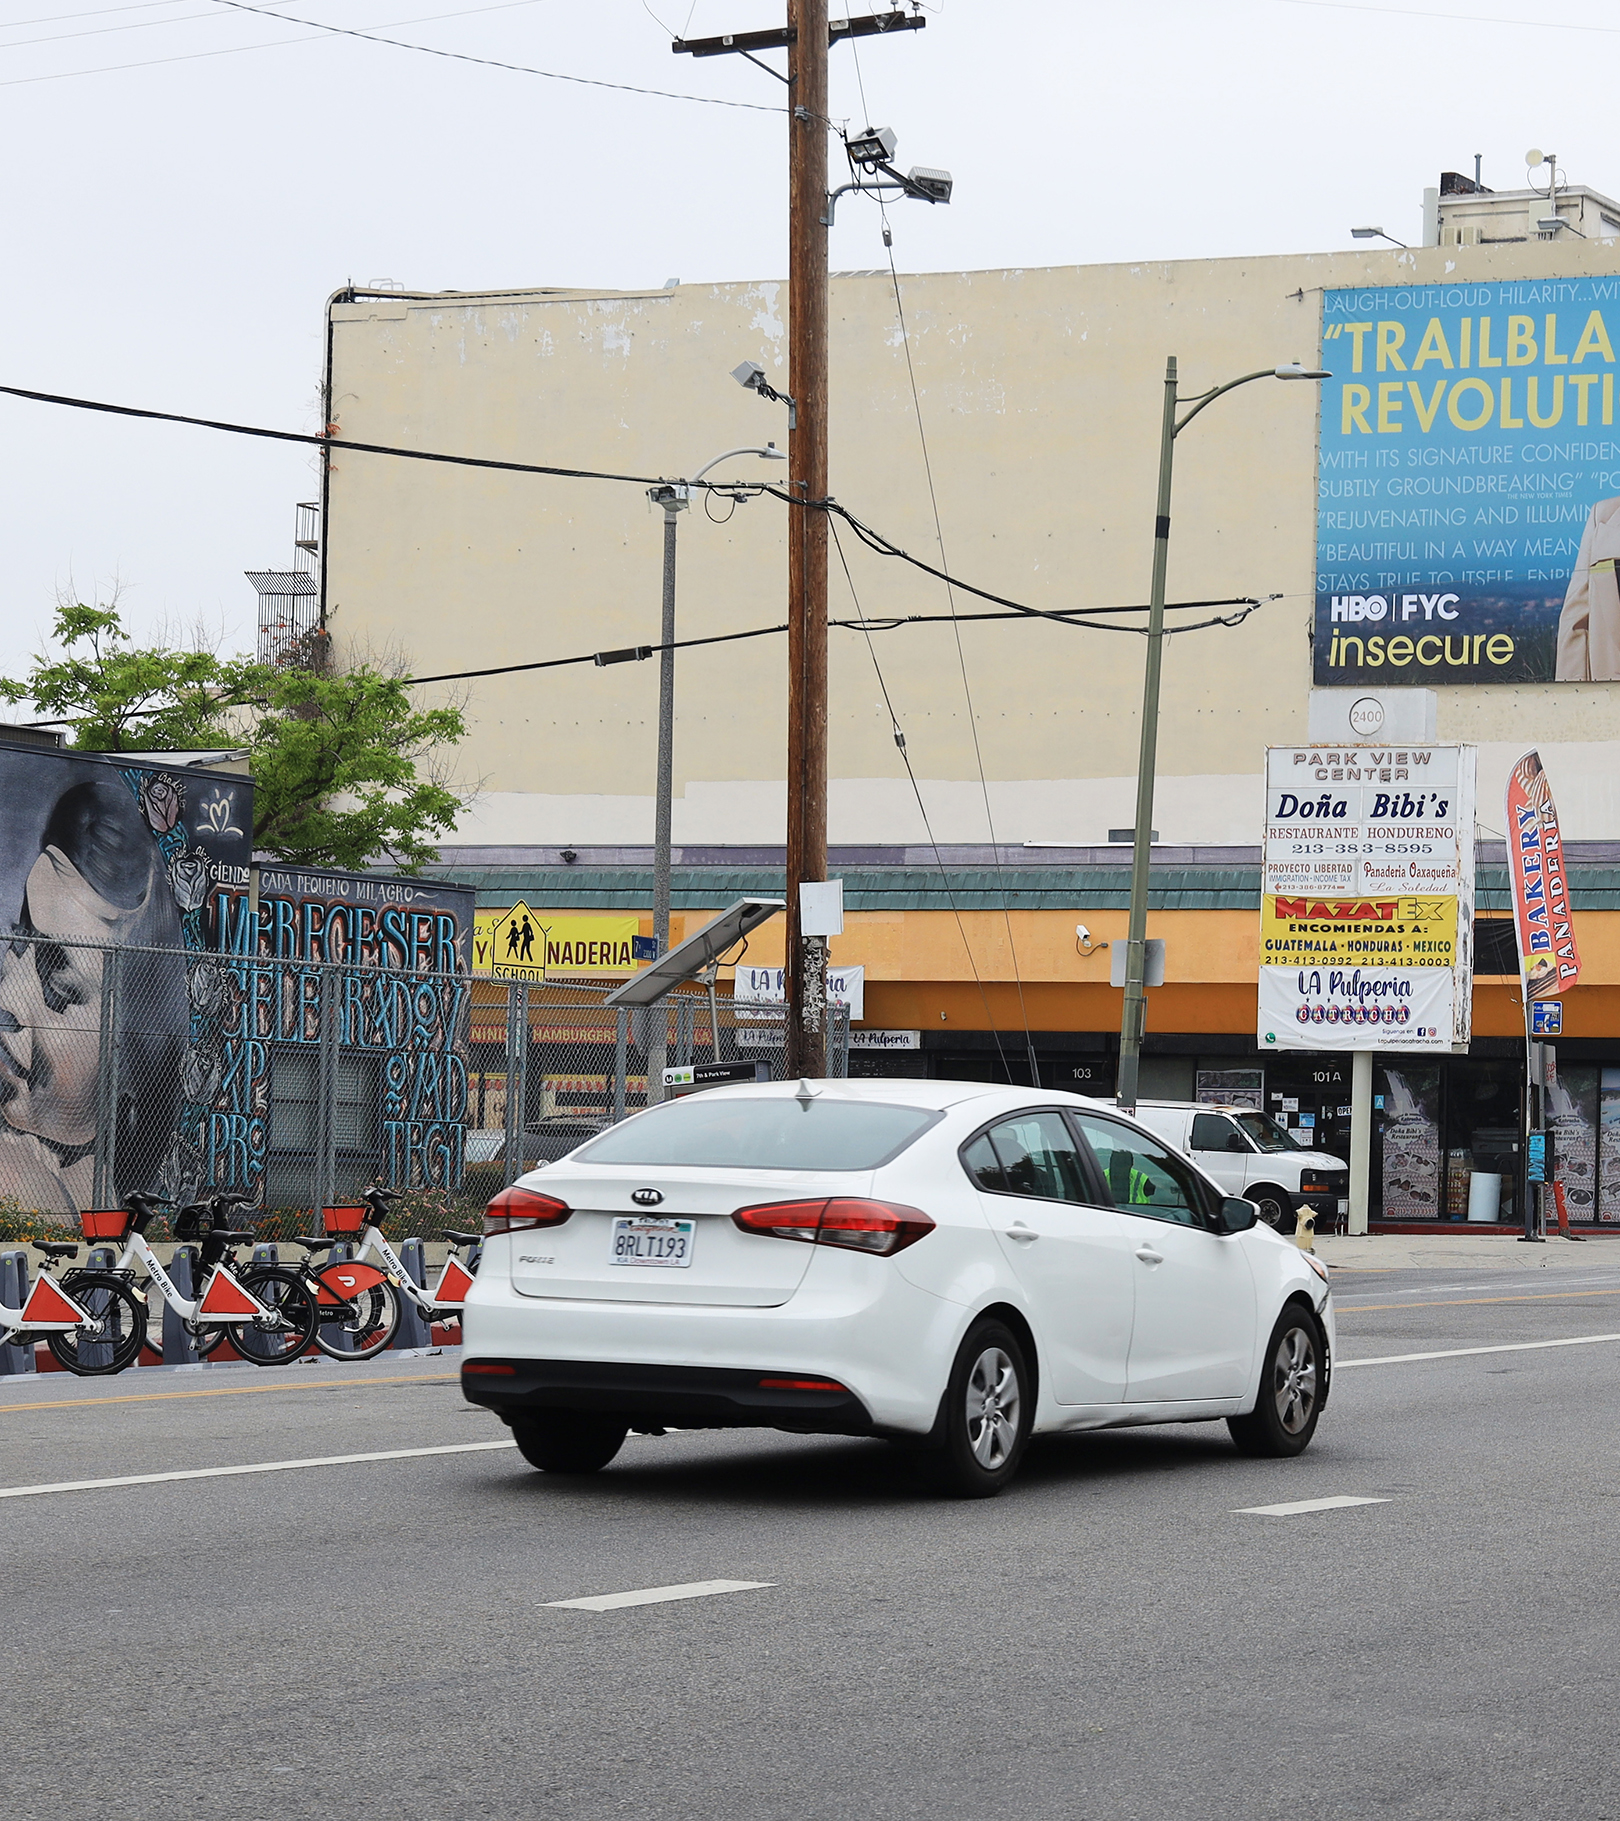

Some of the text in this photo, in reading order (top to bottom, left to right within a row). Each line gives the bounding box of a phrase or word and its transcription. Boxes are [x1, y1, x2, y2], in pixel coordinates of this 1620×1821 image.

[1320, 450, 1367, 470] WITH
[1376, 449, 1400, 468] ITS
[1407, 445, 1513, 467] SIGNATURE
[1319, 478, 1380, 498] SUBTLY
[1473, 505, 1519, 525] AND
[1425, 541, 1445, 560] IN
[1452, 540, 1466, 559] A
[1473, 539, 1517, 558] WAY
[1317, 573, 1370, 592] STAYS
[1330, 593, 1460, 622] HBO FYC
[1329, 628, 1514, 667] insecure
[1352, 710, 1383, 723] 2400
[1293, 751, 1432, 766] PARK VIEW
[1315, 768, 1409, 781] CENTER
[1275, 792, 1449, 819] Doña Bibi's
[1269, 826, 1454, 839] RESTAURANTE HONDURENO
[1291, 843, 1433, 854] 213-383-8595
[1268, 863, 1353, 873] PROYECTO LIBERTAD
[1363, 861, 1456, 881] Panaderia Oaxaqueña
[259, 872, 293, 897] CADA
[1268, 874, 1351, 883] IMMIGRATION INCOME TAX
[1515, 804, 1552, 953] BAKERY
[1369, 881, 1448, 892] La Soledad
[1540, 799, 1578, 980] PANADERIA
[1289, 924, 1428, 933] ENCOMIENDAS A:
[547, 941, 631, 965] NADERIA
[1265, 938, 1451, 953] GUATEMALA HONDURAS MEXICO
[1265, 956, 1450, 966] 213-413-0992 213-413-0003
[495, 966, 543, 981] SCHOOL
[1298, 969, 1413, 1004] LA Pulperia
[1297, 1005, 1410, 1024] CATRACHA
[532, 1028, 618, 1043] HAMBURGERS
[868, 1032, 911, 1047] Pulperia
[1072, 1068, 1092, 1079] 103
[1312, 1071, 1342, 1082] 101 A
[1376, 1097, 1383, 1107] A
[634, 1190, 659, 1202] KIA
[615, 1235, 687, 1259] 8RLT193
[382, 1249, 407, 1285] Metro Bike
[629, 1257, 669, 1265] Downtown
[146, 1259, 173, 1298] Metro Bike
